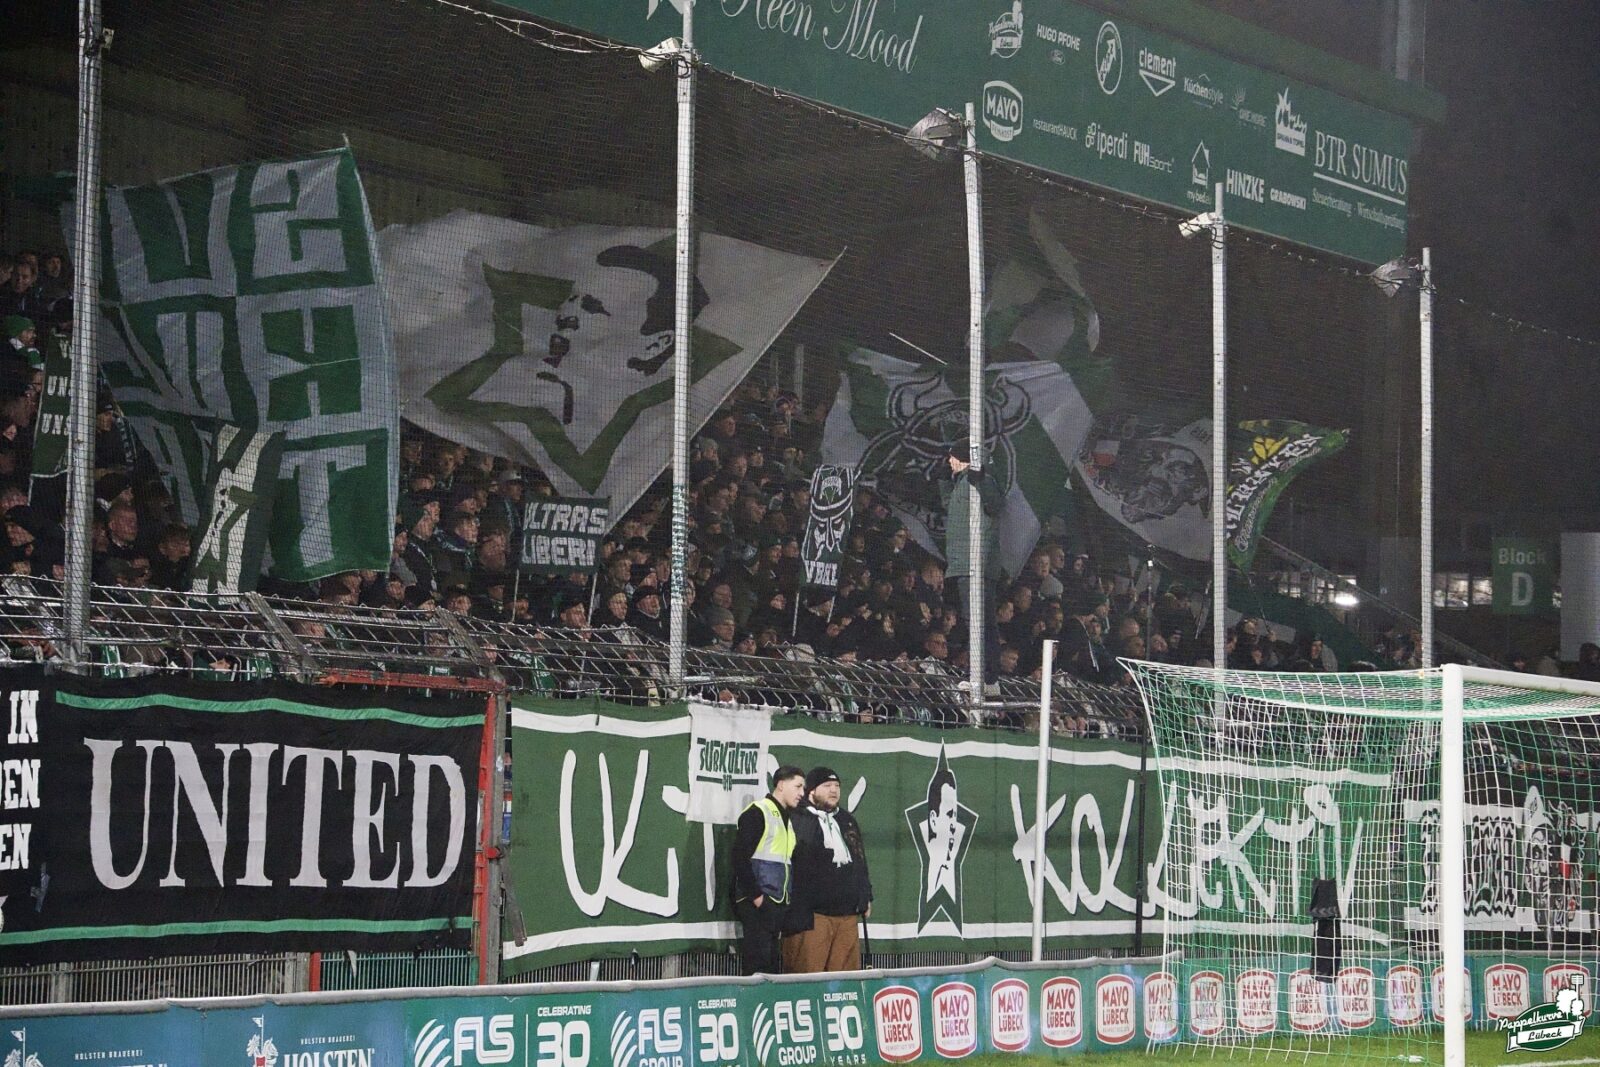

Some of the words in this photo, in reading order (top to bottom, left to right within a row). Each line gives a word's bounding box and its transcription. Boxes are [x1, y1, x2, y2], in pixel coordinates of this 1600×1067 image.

[823, 0, 924, 73] Mood
[1036, 23, 1058, 43] HUGO
[1058, 30, 1081, 52] PFOHE
[1139, 47, 1176, 79] clement
[986, 92, 1019, 123] MAYO
[1097, 123, 1128, 160] iperdi
[1314, 130, 1347, 176] BTR
[1352, 143, 1408, 196] SUMUS
[1225, 168, 1265, 204] HINZKE
[523, 501, 609, 535] ULTRAS
[1511, 572, 1532, 606] D
[8, 689, 40, 744] IN
[699, 740, 759, 775] SUBKULTUR
[0, 758, 41, 810] EN
[83, 736, 467, 889] UNITED
[1195, 981, 1218, 1001] MAYO
[1242, 979, 1271, 1000] MAYO
[1296, 978, 1321, 998] MAYO
[1341, 977, 1369, 996] MAYO
[1492, 974, 1521, 991] MAYO
[697, 998, 737, 1010] CELEBRATING
[823, 991, 858, 1002] CELEBRATING
[939, 993, 969, 1018] MAYO
[997, 991, 1024, 1013] MAYO
[1046, 988, 1075, 1011] MAYO
[1102, 986, 1129, 1008] MAYO
[1492, 989, 1523, 1006] LÜBECK
[537, 1004, 592, 1017] CELEBRATING
[774, 1000, 815, 1044] FLS
[881, 998, 913, 1023] MAYO
[997, 1012, 1024, 1032] LÜBECK
[1046, 1009, 1075, 1029] LÜBECK
[1102, 1007, 1129, 1025] LÜBECK
[454, 1014, 514, 1066] FLS
[638, 1007, 683, 1055] FLS
[698, 1013, 740, 1063] 30
[825, 1005, 864, 1051] 30
[883, 1022, 914, 1043] LÜBECK
[940, 1018, 970, 1038] LÜBECK
[74, 1051, 106, 1061] HOLSTEN
[537, 1020, 590, 1067] 30
[779, 1046, 817, 1066] GROUP
[830, 1053, 867, 1067] YEARS
